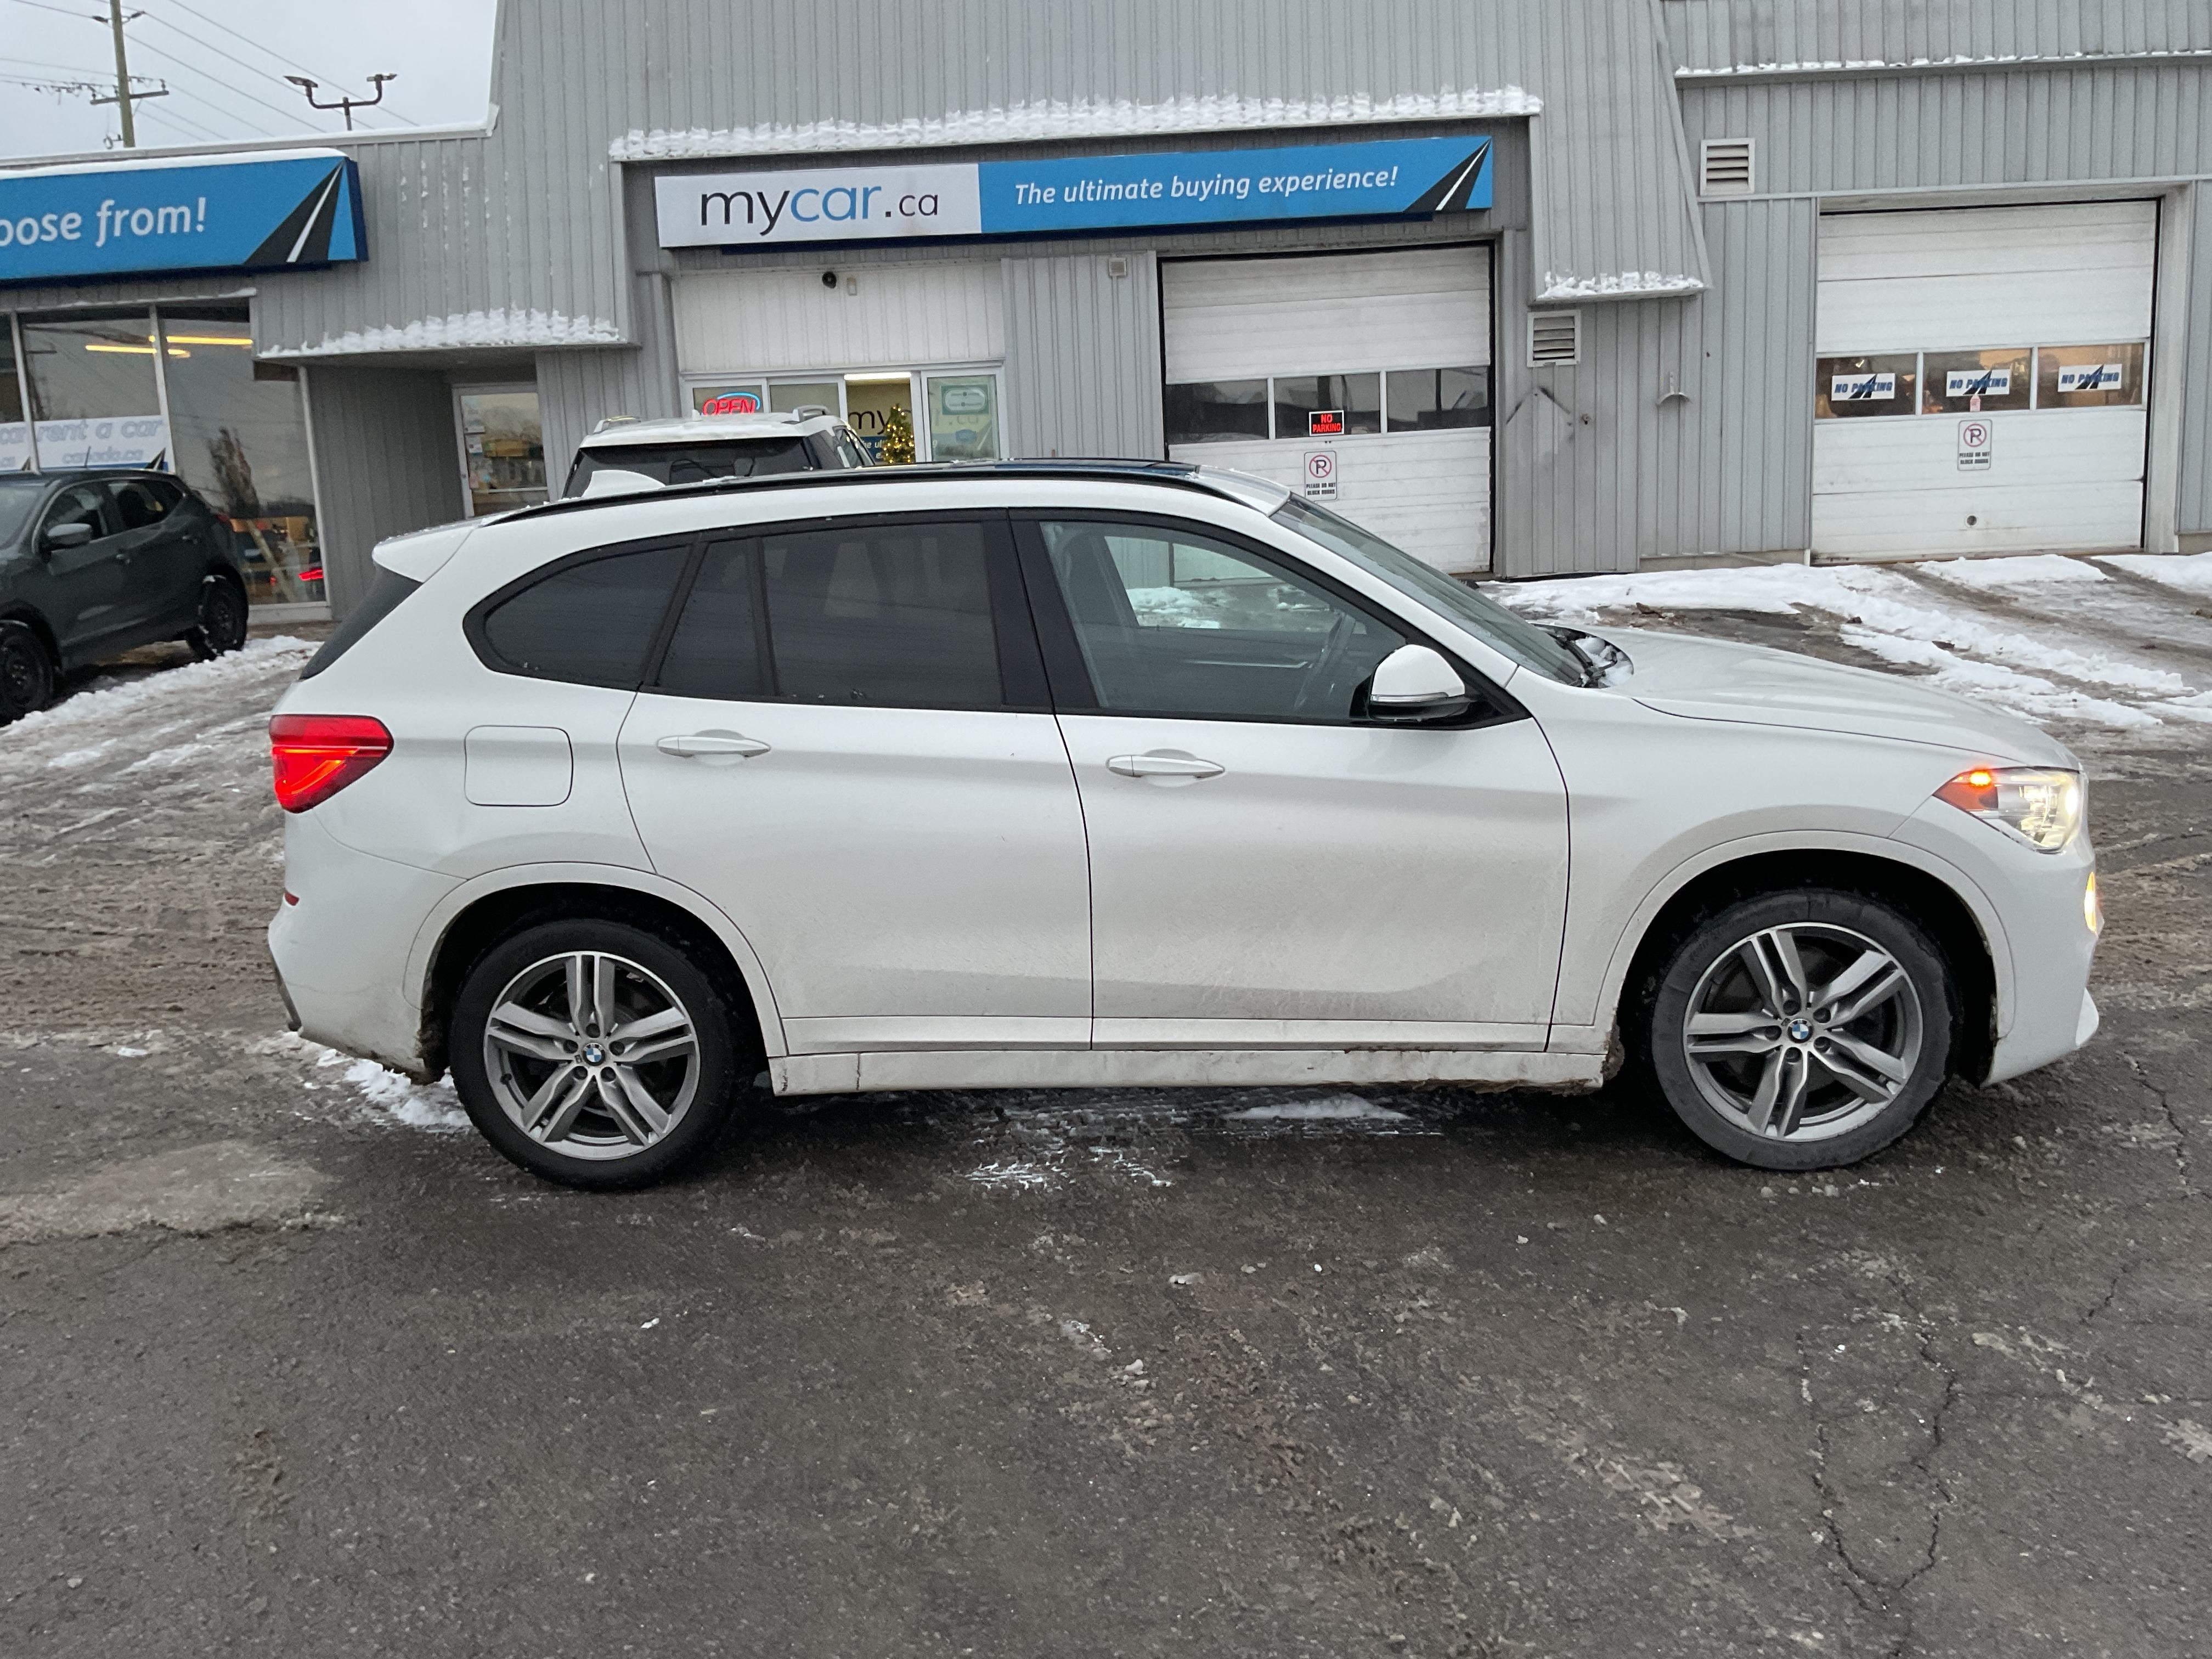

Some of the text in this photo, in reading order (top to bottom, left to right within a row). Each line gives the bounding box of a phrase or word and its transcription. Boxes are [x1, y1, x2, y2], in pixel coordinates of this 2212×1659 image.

[1015, 166, 1398, 205] The ultimate buying experience!
[95, 197, 206, 247] from!
[1312, 422, 1341, 433] PARKING
[1321, 414, 1333, 423] NO
[36, 419, 163, 442] rent a car
